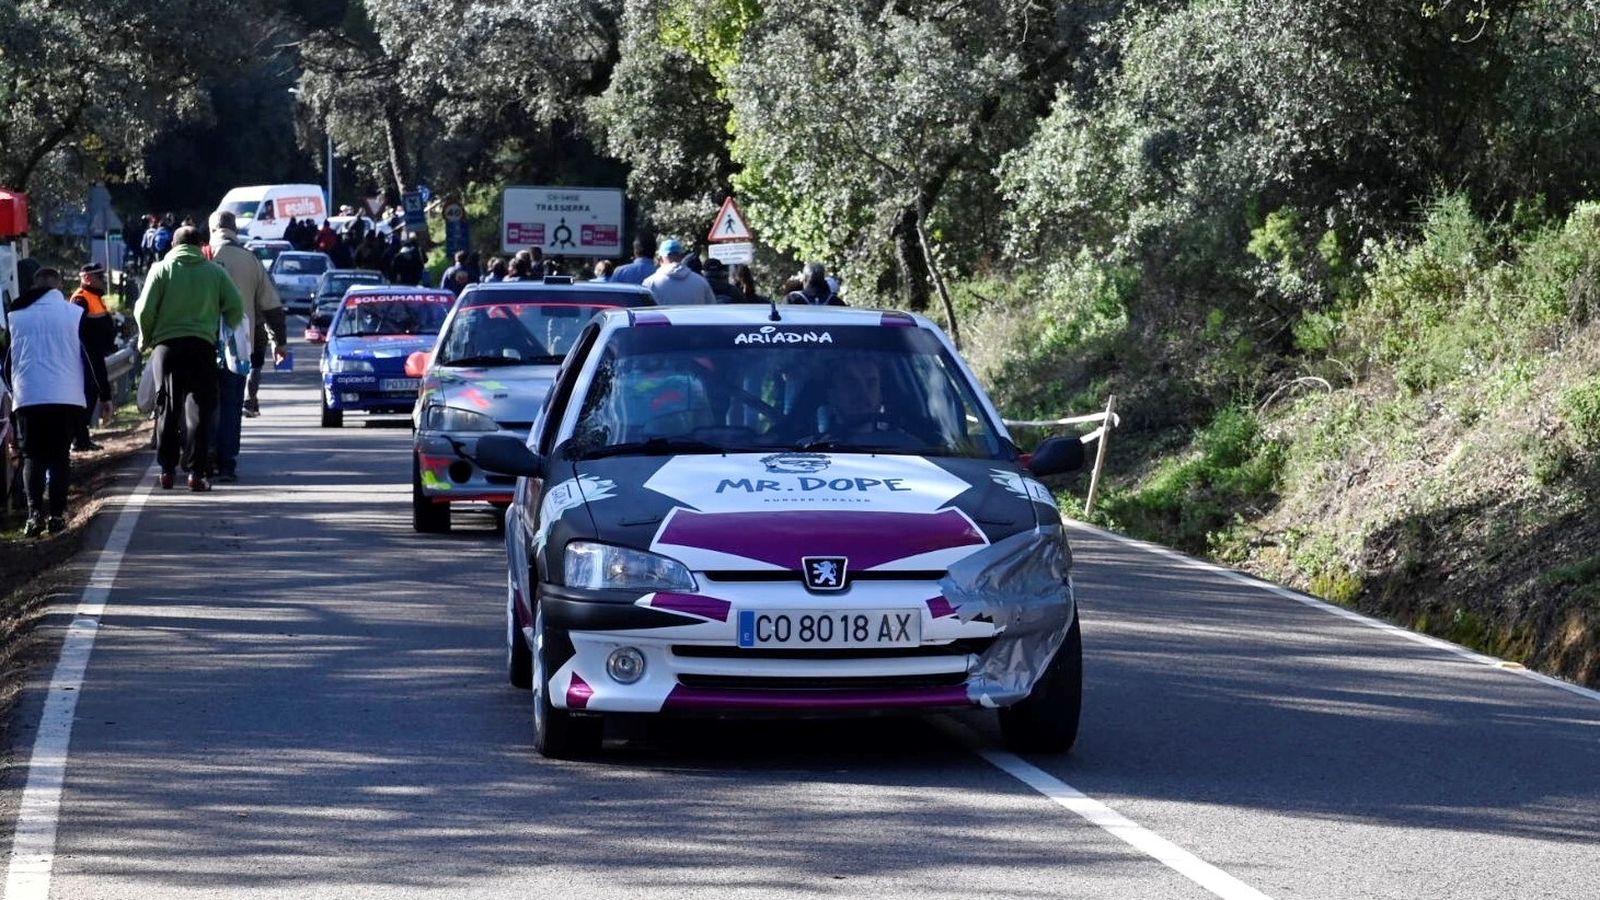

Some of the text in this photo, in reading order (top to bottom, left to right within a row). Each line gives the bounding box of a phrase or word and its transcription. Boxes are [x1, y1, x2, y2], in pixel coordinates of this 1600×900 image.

[447, 208, 461, 216] 40
[536, 204, 590, 212] TRASSIERRA
[355, 295, 422, 304] SOLGUMAR
[734, 326, 833, 345] ARIADNA
[337, 375, 376, 384] copicentro
[877, 613, 911, 642] AX
